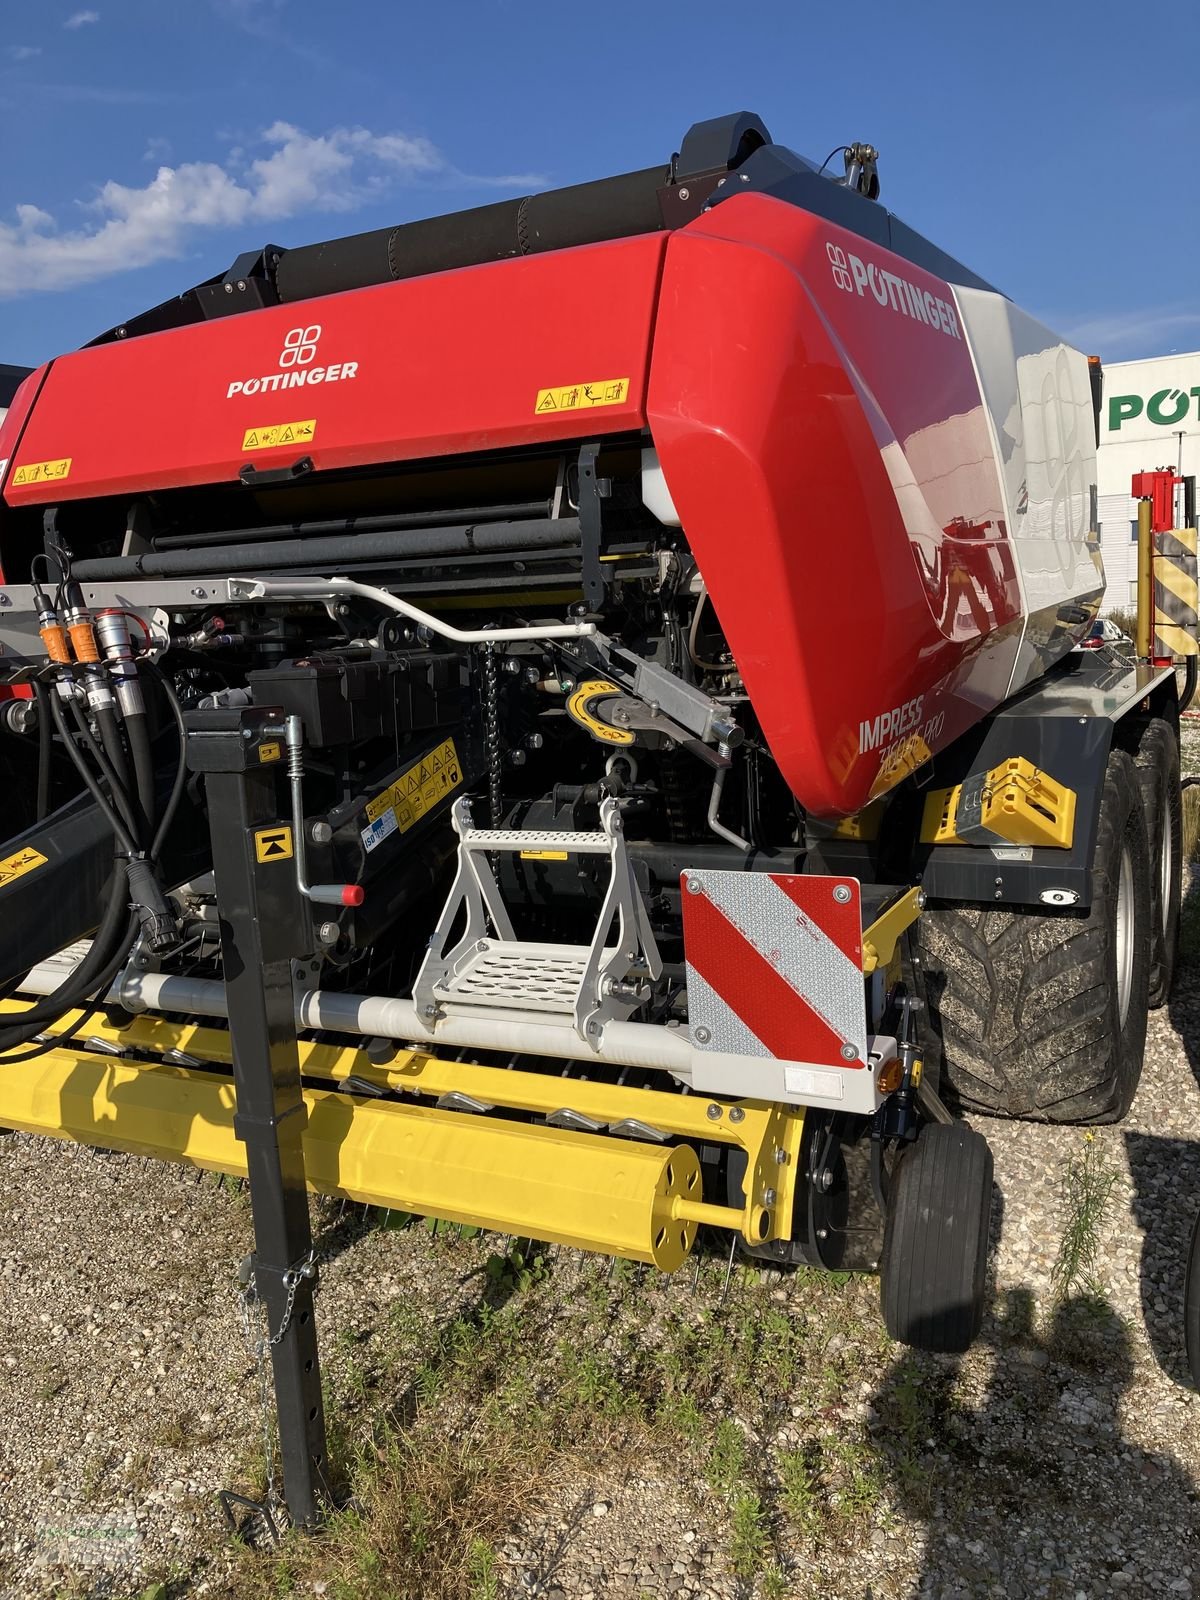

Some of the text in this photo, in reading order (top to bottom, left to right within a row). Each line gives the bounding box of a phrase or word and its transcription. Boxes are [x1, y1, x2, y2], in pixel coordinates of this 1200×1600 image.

[848, 253, 961, 341] PÖTTINGER
[226, 361, 359, 399] PÖTTINGER
[859, 694, 925, 755] IMPRESS
